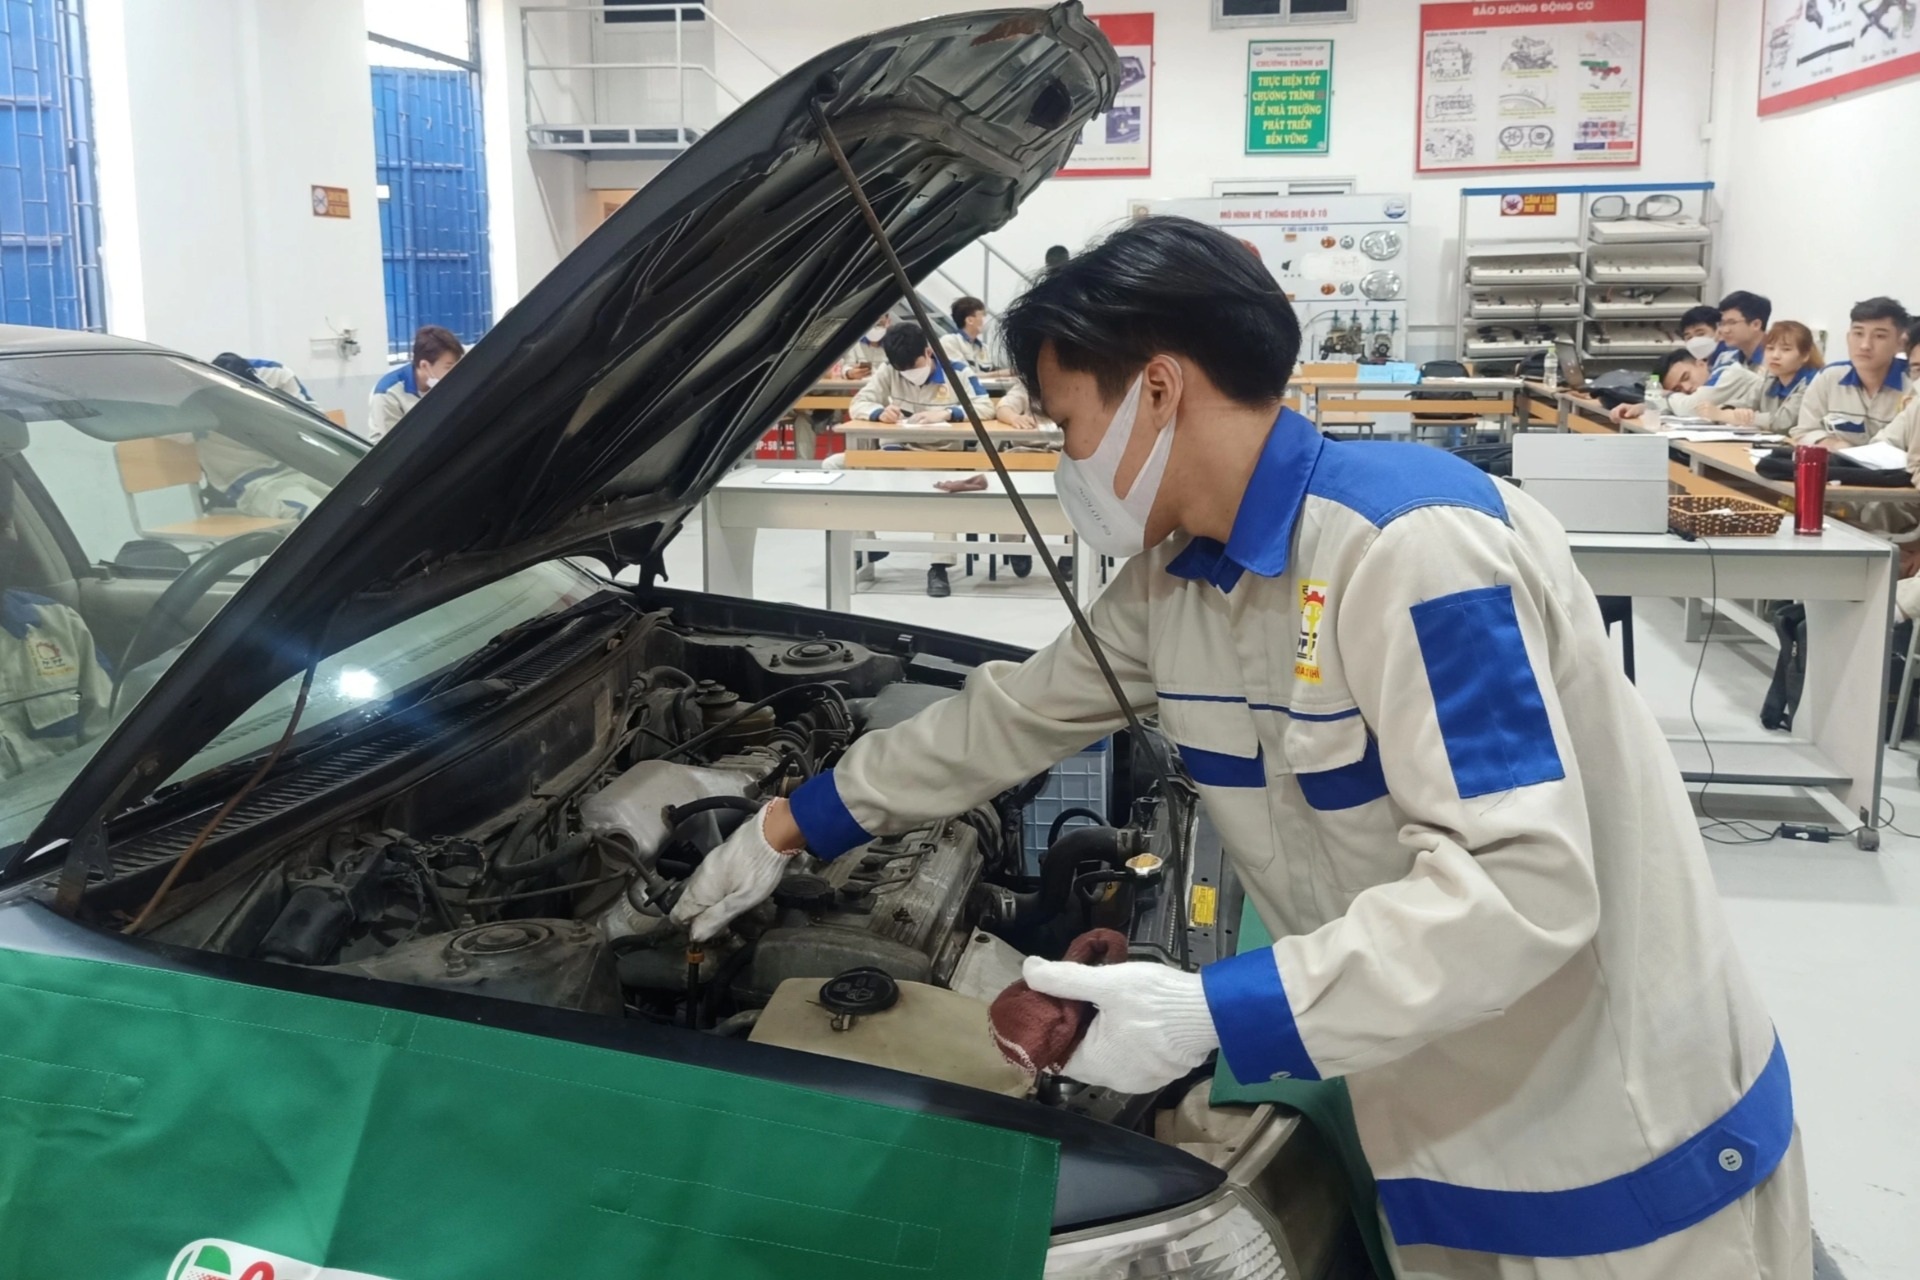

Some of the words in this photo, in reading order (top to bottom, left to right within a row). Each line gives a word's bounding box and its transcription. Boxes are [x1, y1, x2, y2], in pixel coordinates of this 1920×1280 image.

[1258, 75, 1281, 88] THỰC
[1282, 74, 1303, 88] HIỆN
[1304, 72, 1321, 86] TỐT
[1252, 89, 1287, 101] CHƯƠNG
[1288, 88, 1315, 101] TRÌNH
[1267, 103, 1286, 116] NHÀ
[1263, 117, 1286, 130] PHÁT
